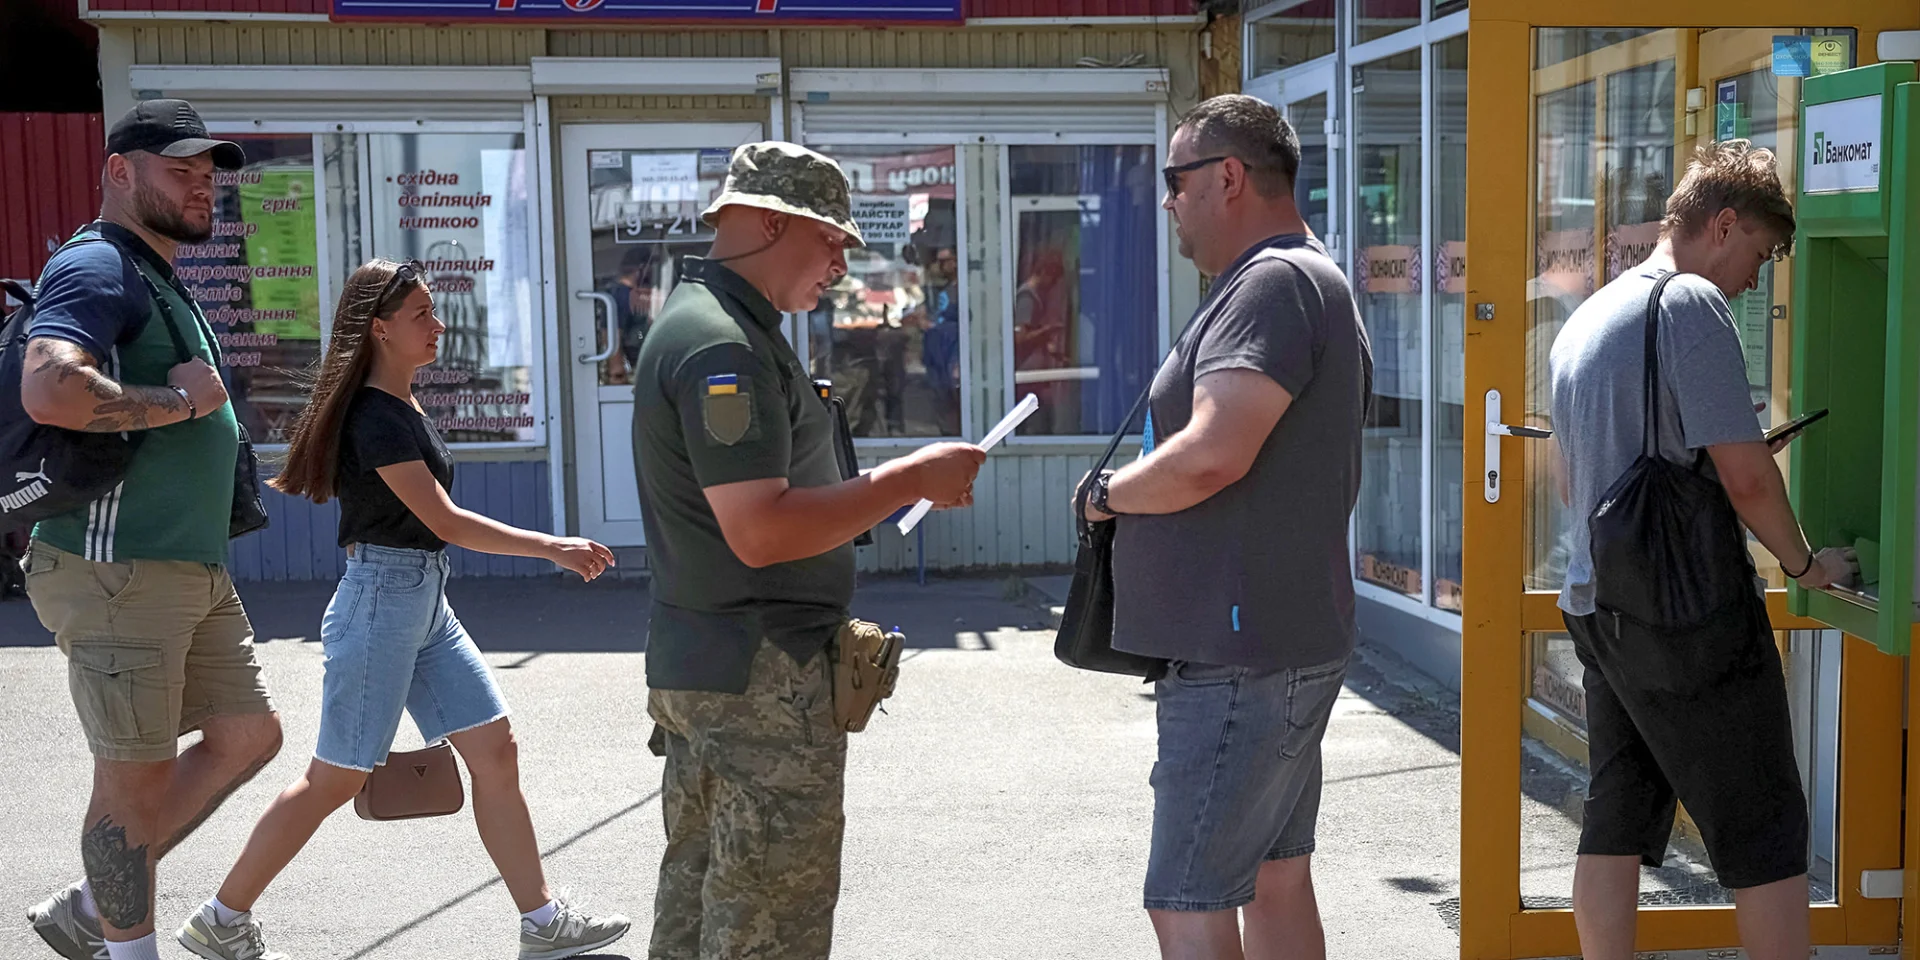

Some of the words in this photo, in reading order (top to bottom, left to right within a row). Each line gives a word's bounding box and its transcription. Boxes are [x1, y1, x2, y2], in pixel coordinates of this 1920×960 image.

[1825, 140, 1873, 164] Банкомат
[214, 171, 262, 186] ижки
[396, 169, 460, 186] східна
[397, 192, 492, 210] депіляція
[399, 216, 479, 229] ниткою
[852, 209, 905, 218] МАЙСТЕР
[212, 219, 257, 238] ікюр
[626, 216, 642, 236] 9
[175, 243, 240, 258] шелак
[176, 264, 313, 283] нарощування
[424, 256, 495, 275] піляція
[190, 283, 242, 301] ігтів
[427, 280, 474, 293] ском
[205, 304, 298, 326] рбування
[221, 352, 262, 367] осся
[413, 367, 473, 387] ірсінг
[416, 391, 530, 406] осметологія
[434, 413, 535, 433] афінотерапія
[0, 480, 49, 513] PUMA
